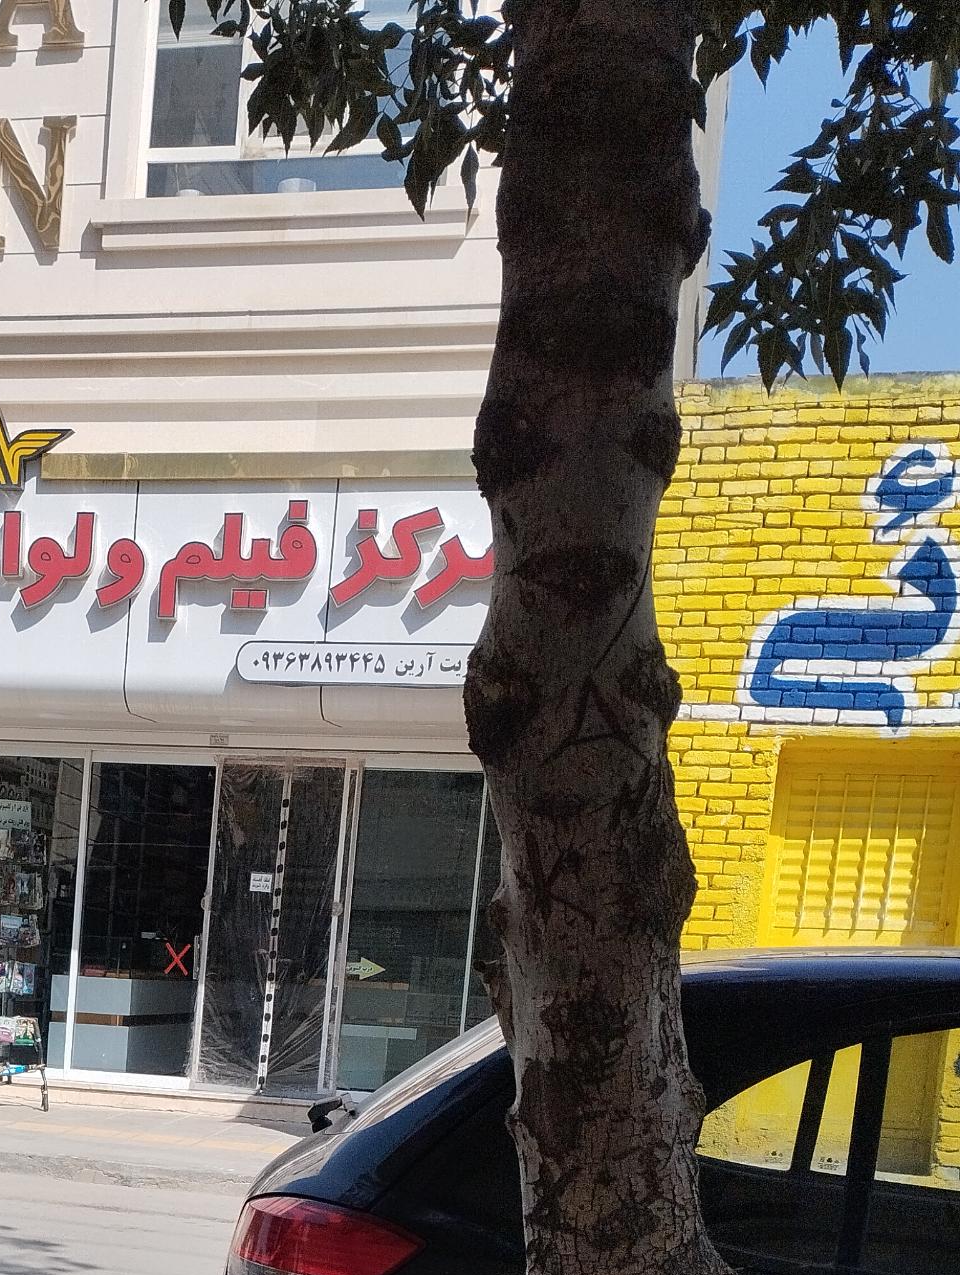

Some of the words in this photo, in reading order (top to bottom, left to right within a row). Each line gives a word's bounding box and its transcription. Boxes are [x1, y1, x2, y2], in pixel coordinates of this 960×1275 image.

[95, 537, 147, 608] و
[157, 500, 319, 618] فیلم
[329, 507, 495, 608] رکز
[253, 650, 386, 674] ۰۹۳۶۳۸۹۳۴۴۵
[395, 652, 436, 677] آرین
